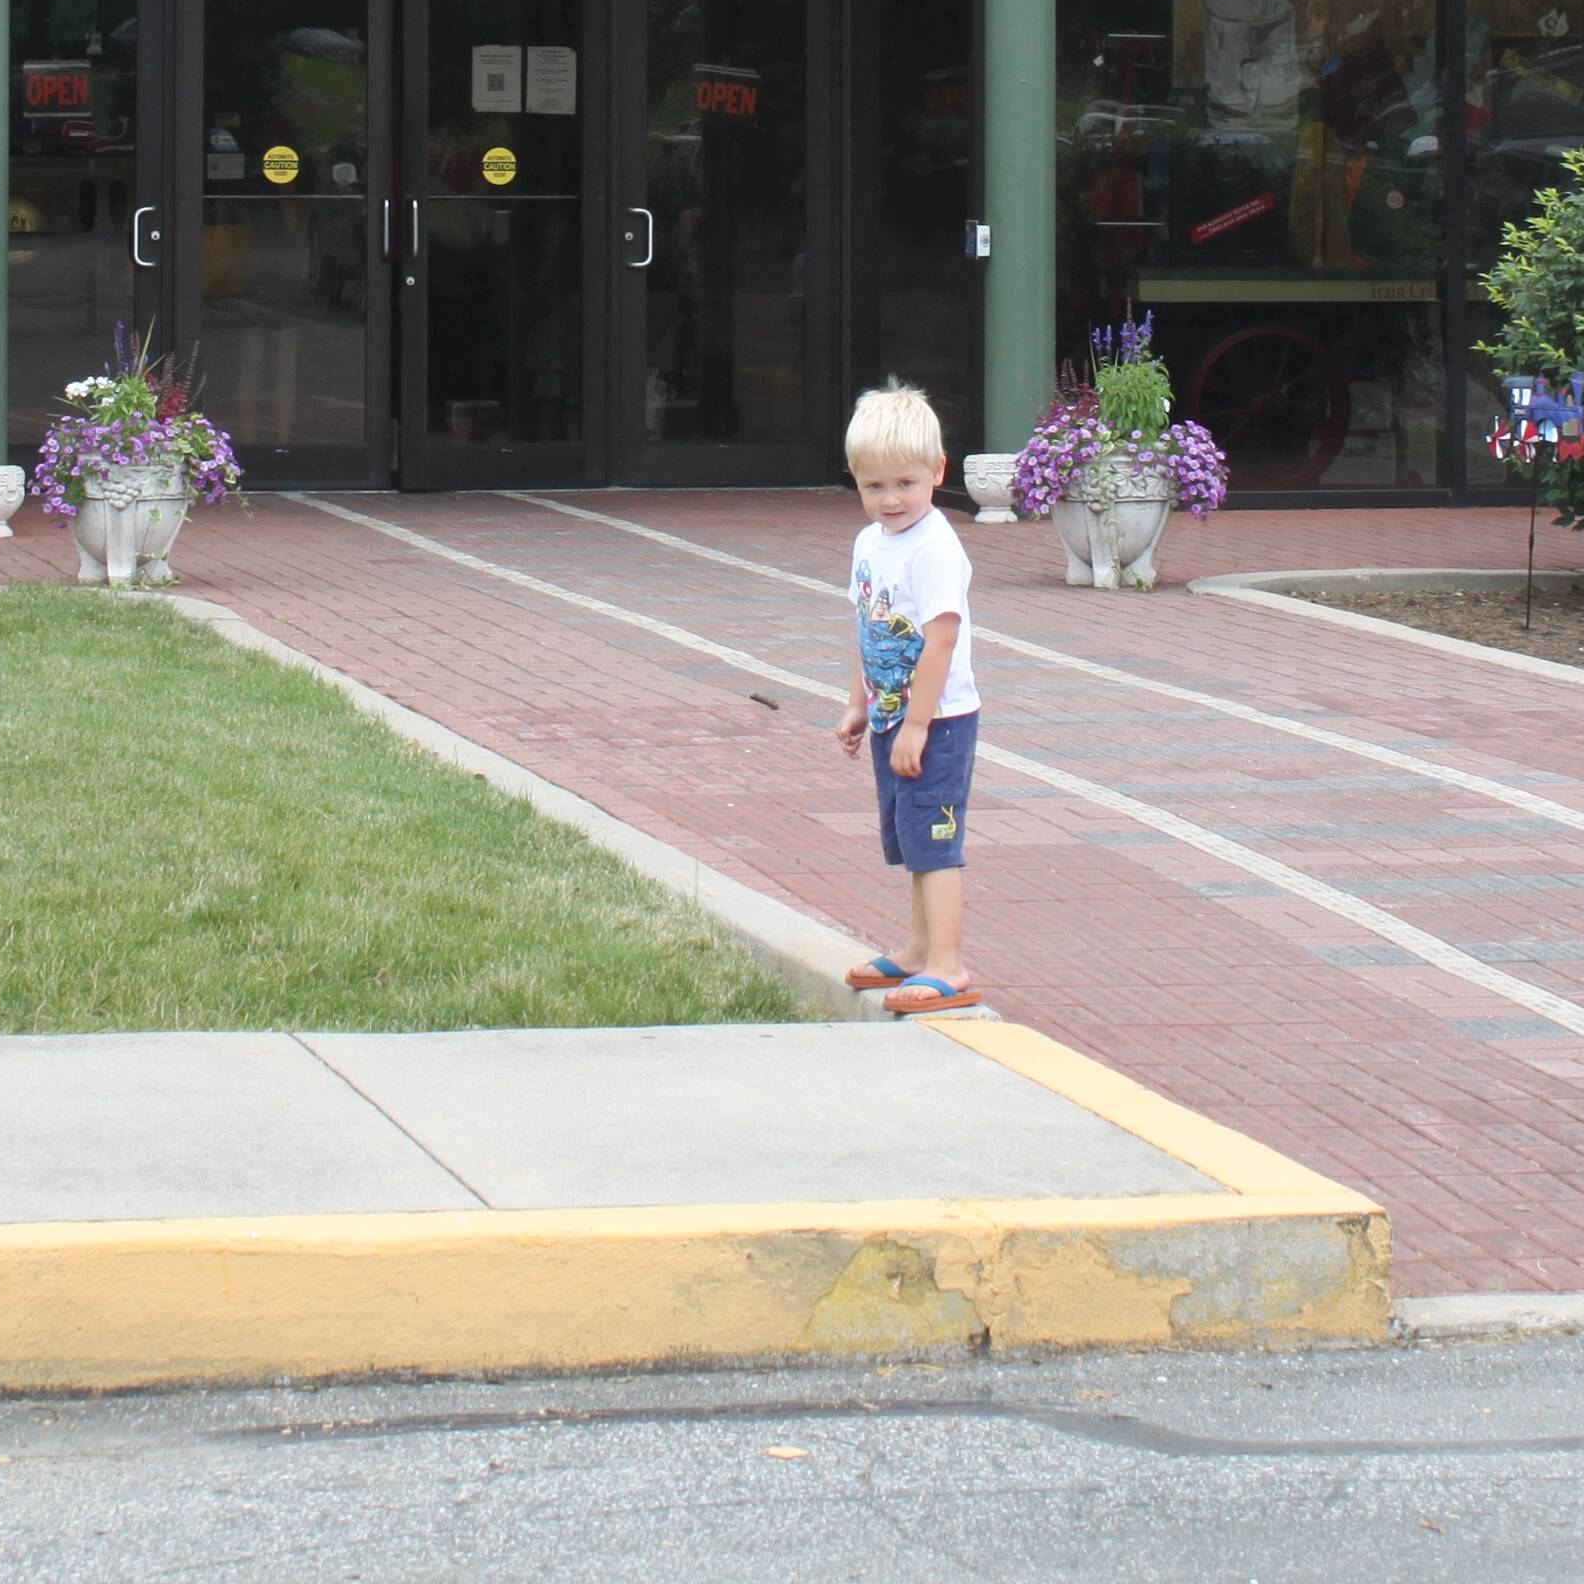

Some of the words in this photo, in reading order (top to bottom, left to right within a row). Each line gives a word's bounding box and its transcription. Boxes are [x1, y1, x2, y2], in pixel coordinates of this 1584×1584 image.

[26, 74, 89, 107] OPEN
[696, 80, 758, 116] OPEN
[264, 160, 298, 169] CAUTION
[483, 162, 516, 170] CAUTION
[1369, 282, 1405, 300] Train
